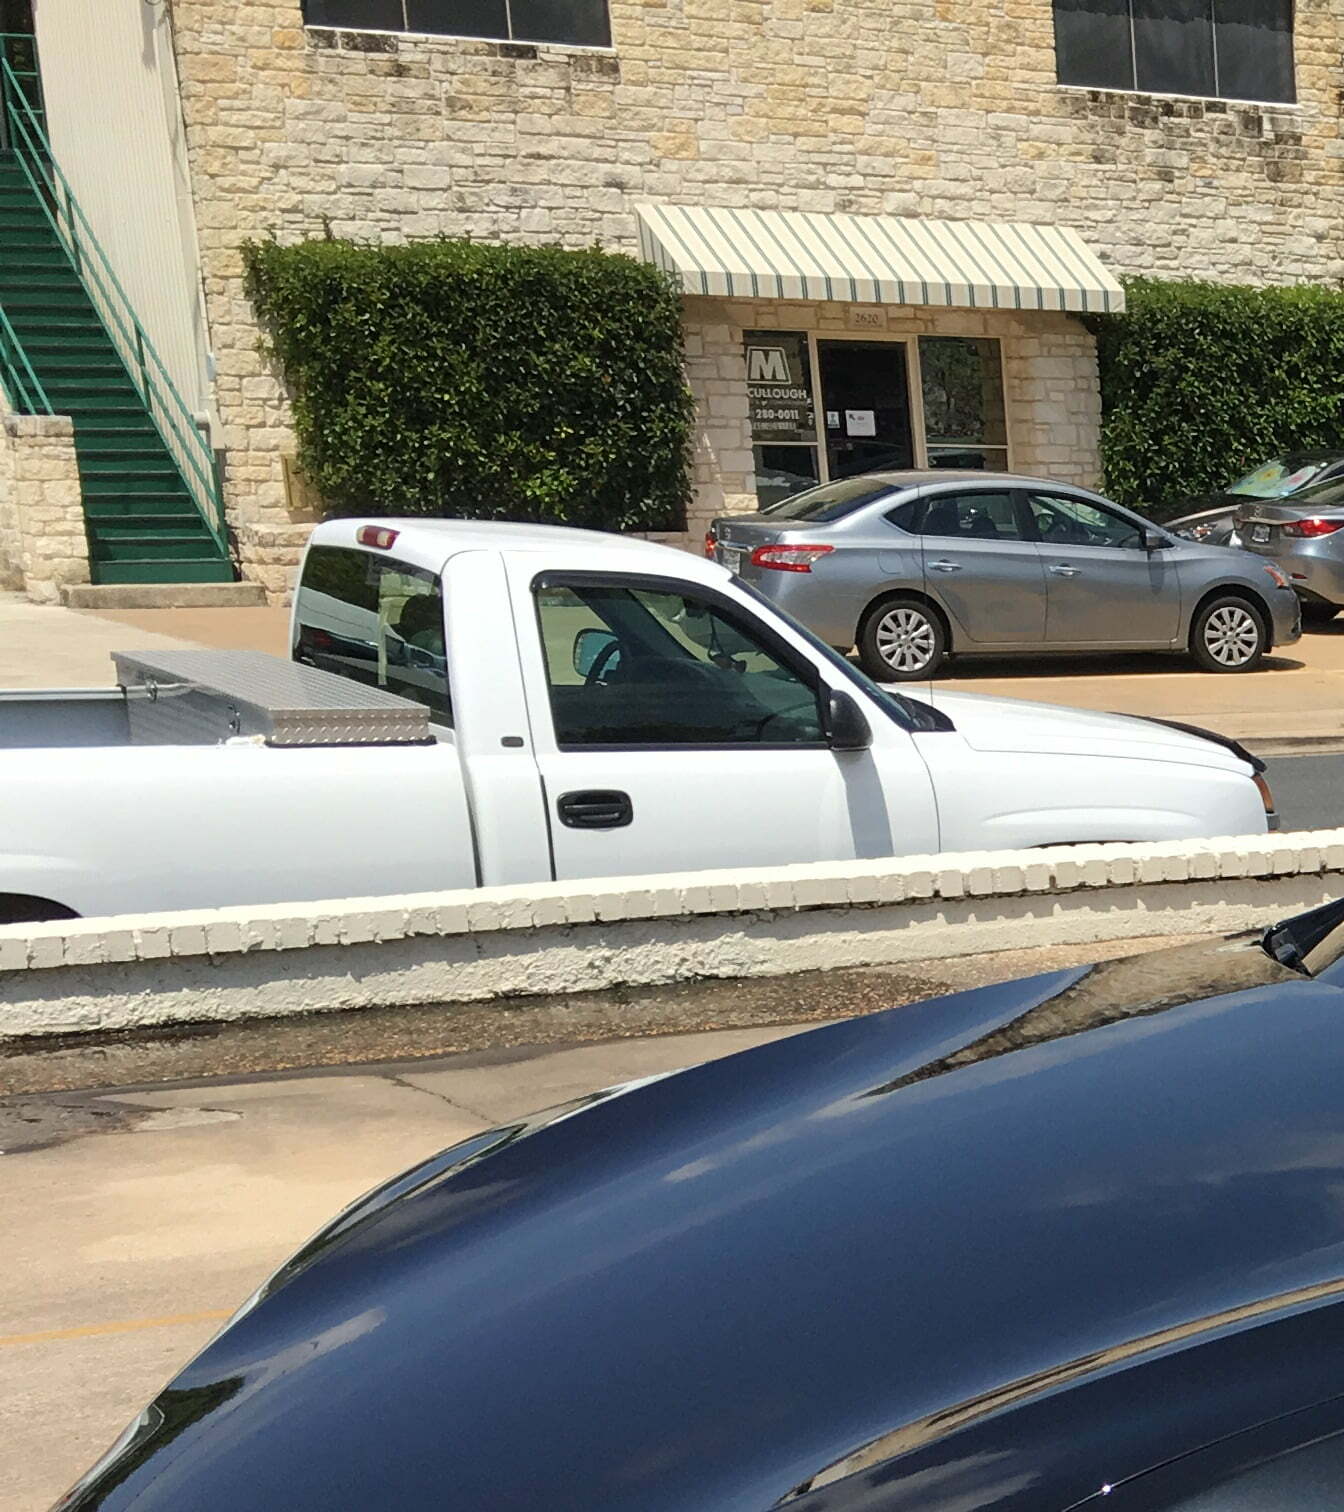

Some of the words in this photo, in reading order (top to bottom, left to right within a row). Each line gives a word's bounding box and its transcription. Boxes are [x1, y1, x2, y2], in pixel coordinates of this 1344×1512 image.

[750, 350, 787, 380] M
[746, 388, 807, 399] CULLOUGH
[755, 408, 800, 419] 280-0011
